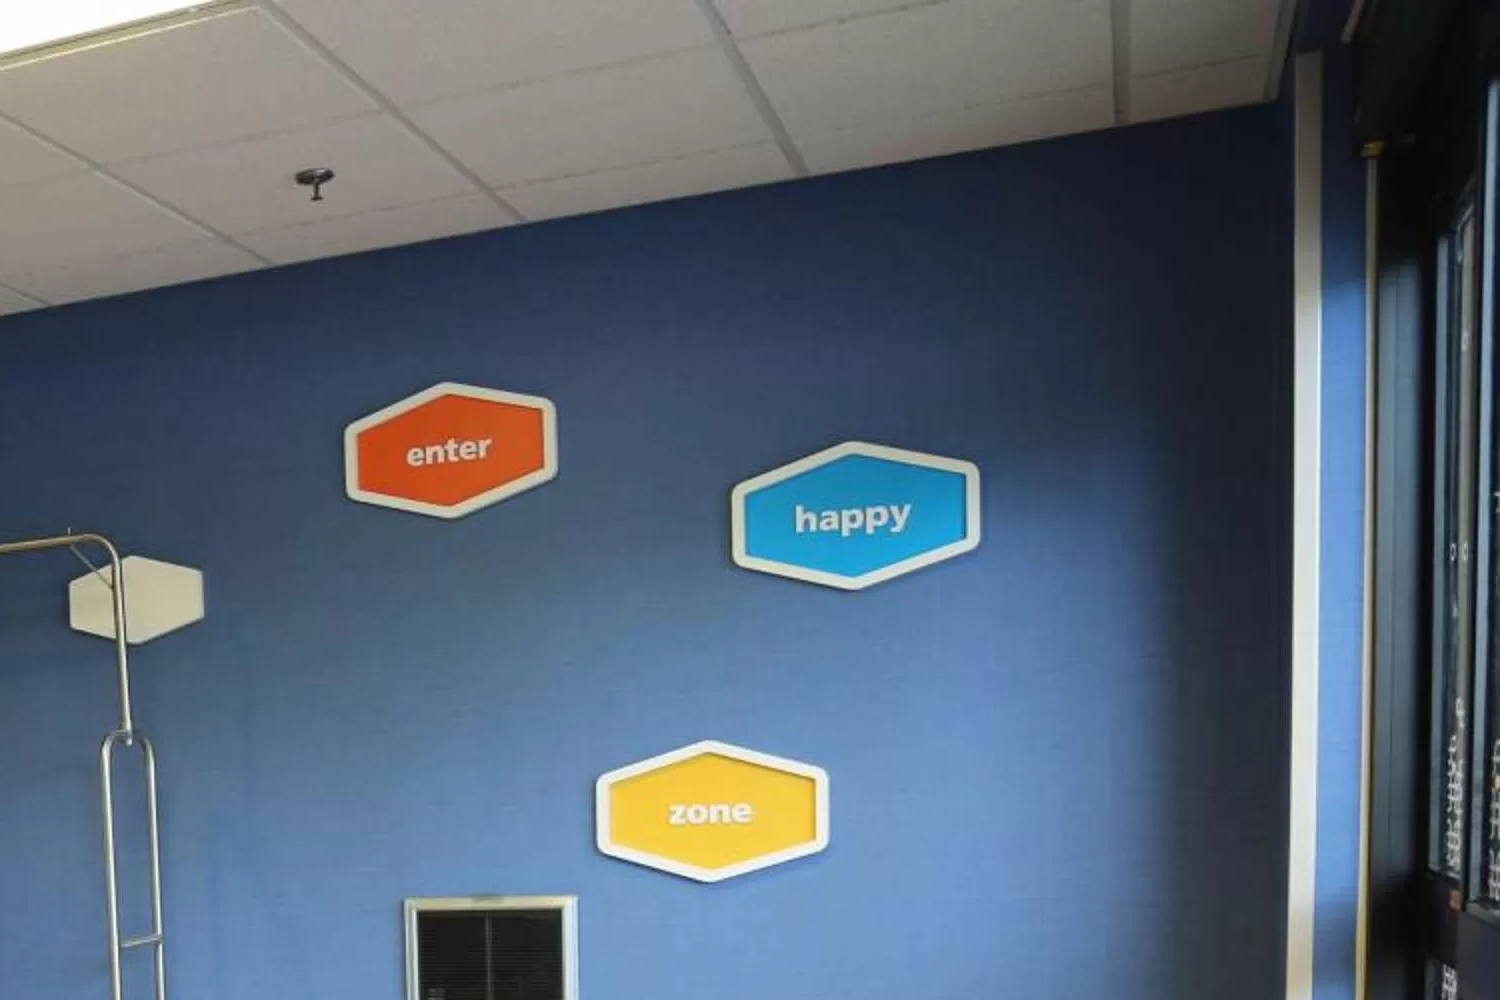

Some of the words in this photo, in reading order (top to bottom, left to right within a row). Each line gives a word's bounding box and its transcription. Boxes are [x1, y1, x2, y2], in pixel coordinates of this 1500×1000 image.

[406, 438, 492, 467] enter
[795, 504, 912, 537] happy
[668, 803, 753, 825] zone
